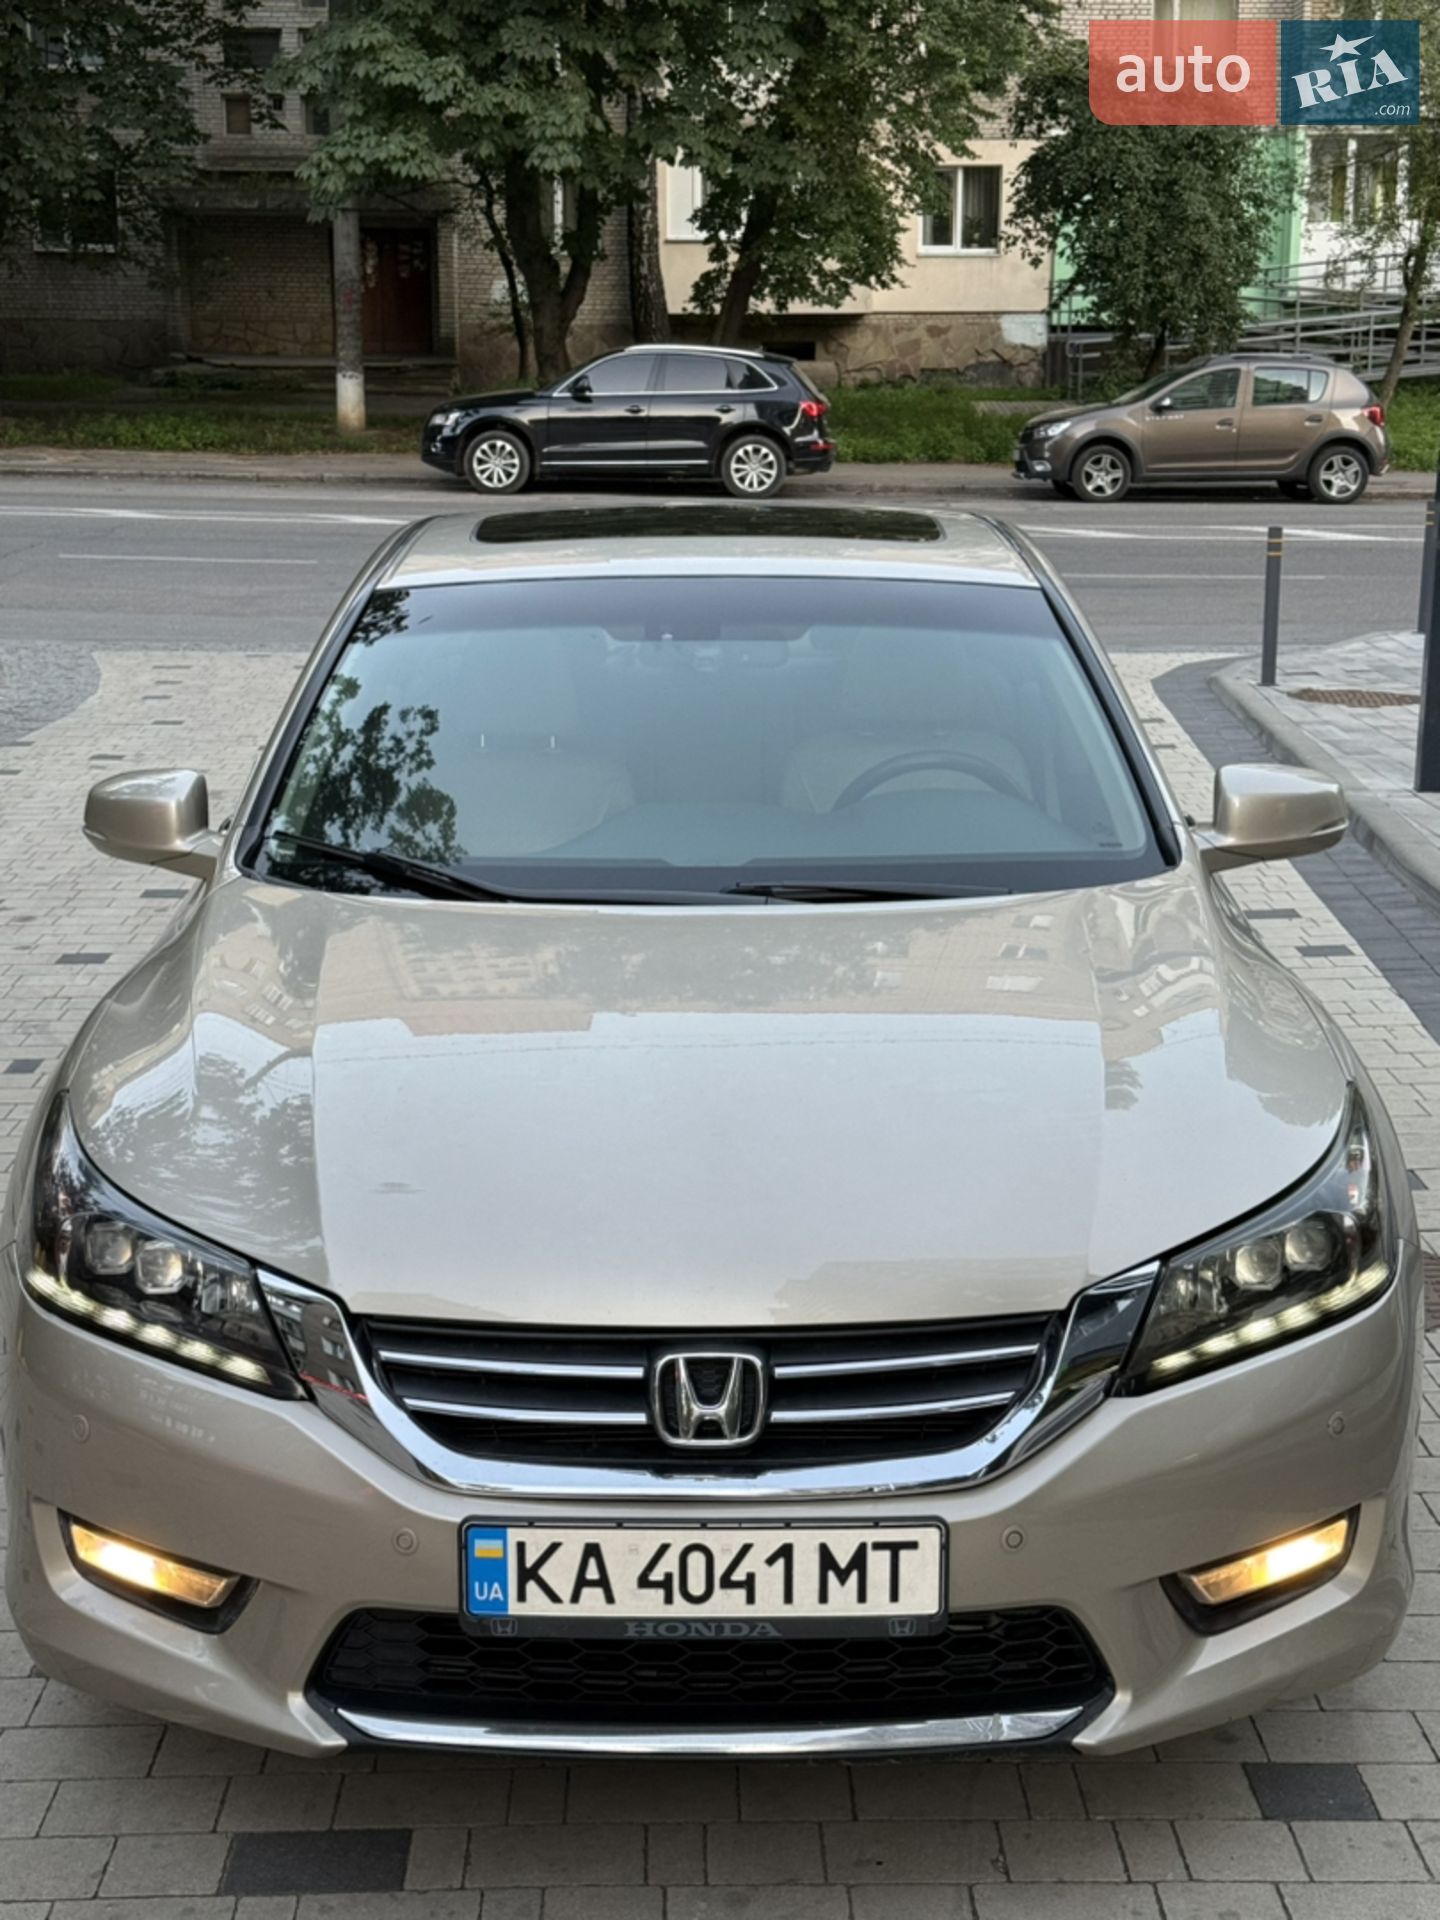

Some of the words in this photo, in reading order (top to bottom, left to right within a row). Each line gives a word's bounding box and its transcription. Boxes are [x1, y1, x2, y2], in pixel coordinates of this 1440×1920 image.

[515, 1541, 616, 1604] KA
[637, 1542, 794, 1604] 4041
[818, 1540, 919, 1604] MT
[474, 1582, 504, 1601] UA
[624, 1621, 783, 1637] HONDA
